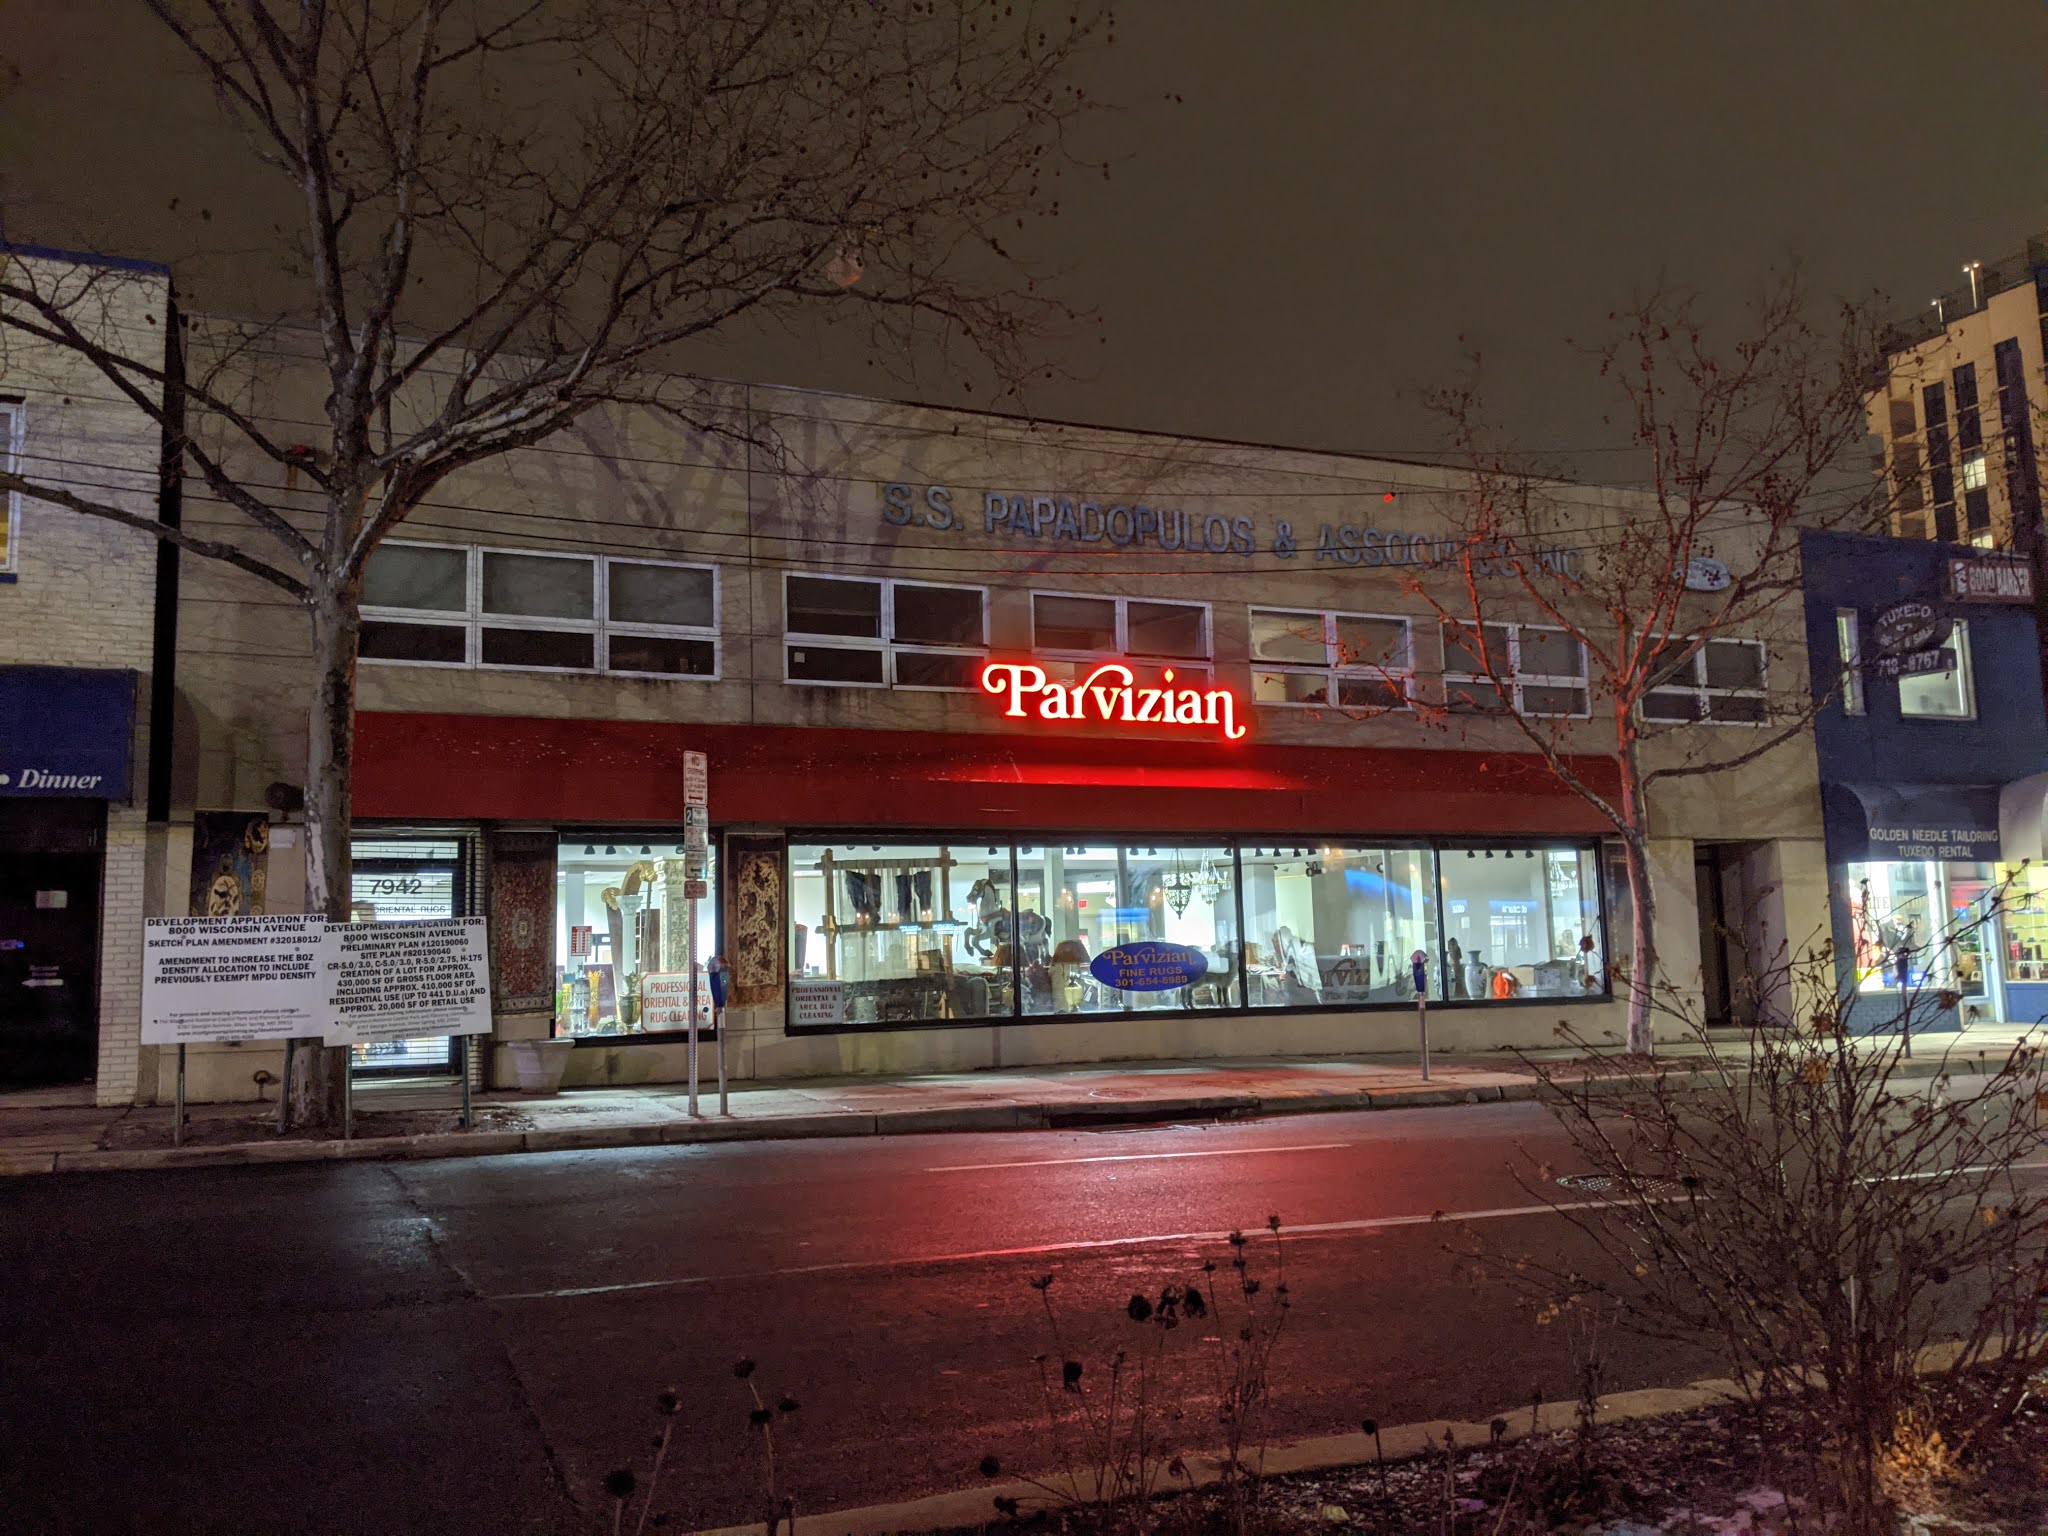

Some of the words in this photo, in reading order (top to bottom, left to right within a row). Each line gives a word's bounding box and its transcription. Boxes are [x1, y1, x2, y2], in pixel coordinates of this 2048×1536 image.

[882, 482, 964, 531] S.S.
[982, 491, 1256, 557] PAPADOPULOS
[1272, 519, 1298, 560] &
[981, 663, 1246, 739] Parvizian
[18, 768, 102, 790] Dinner
[1870, 828, 1908, 841] GOLDEN
[1912, 829, 1948, 842] NEEDLE
[1952, 829, 1998, 842] TAILORING
[1898, 846, 1934, 857] TUXEDO
[1938, 846, 1974, 858] RENTAL
[368, 878, 422, 895] 7942
[148, 918, 228, 926] DEVELOPMENT
[230, 916, 300, 925] APPLICATION
[324, 923, 395, 933] DEVELOPMENT
[398, 920, 461, 929] APPLICATION
[463, 918, 484, 926] FOR:
[199, 925, 260, 934] WISCONSIN
[264, 924, 306, 932] AVENUE
[343, 934, 368, 942] 8000
[370, 931, 426, 941] WISCONSIN
[428, 929, 466, 938] AVENUE
[148, 939, 183, 948] SKETCH
[186, 938, 209, 946] PLAN
[211, 937, 267, 946] AMENDMENT
[340, 942, 396, 952] PRELIMINARY
[422, 939, 468, 947] #120190060
[403, 948, 451, 957] #820190040
[1102, 946, 1197, 966] Parvizian
[159, 957, 216, 966] AMENDMENT
[232, 955, 276, 963] INCREASE
[296, 954, 314, 962] BOZ
[162, 966, 199, 974] DENSITY
[202, 965, 256, 973] ALLOCATION
[272, 963, 310, 971] INCLUDE
[340, 969, 380, 978] CREATION
[437, 964, 472, 972] APPROX.
[1120, 968, 1146, 977] FINE
[1150, 966, 1183, 975] RUGS
[155, 975, 212, 984] PREVIOUSLY
[214, 974, 249, 982] EXEMPT
[280, 972, 316, 980] DENSITY
[337, 978, 370, 988] 430,000
[397, 975, 424, 983] GROSS
[426, 973, 452, 982] FLOOR
[336, 986, 381, 996] INCLUDING
[384, 984, 419, 993] APPROX.
[421, 982, 452, 991] 410,000
[650, 980, 707, 993] PROFESSIOAL
[329, 995, 382, 1005] RESIDENTIAL
[402, 993, 415, 1001] (UP
[644, 996, 681, 1008] ORIENTAL
[682, 997, 688, 1006] &
[694, 995, 711, 1006] REA
[339, 1004, 376, 1014] APPROX.
[378, 1002, 405, 1011] 20,000
[432, 998, 458, 1006] RETAIL
[650, 1012, 667, 1023] RUG
